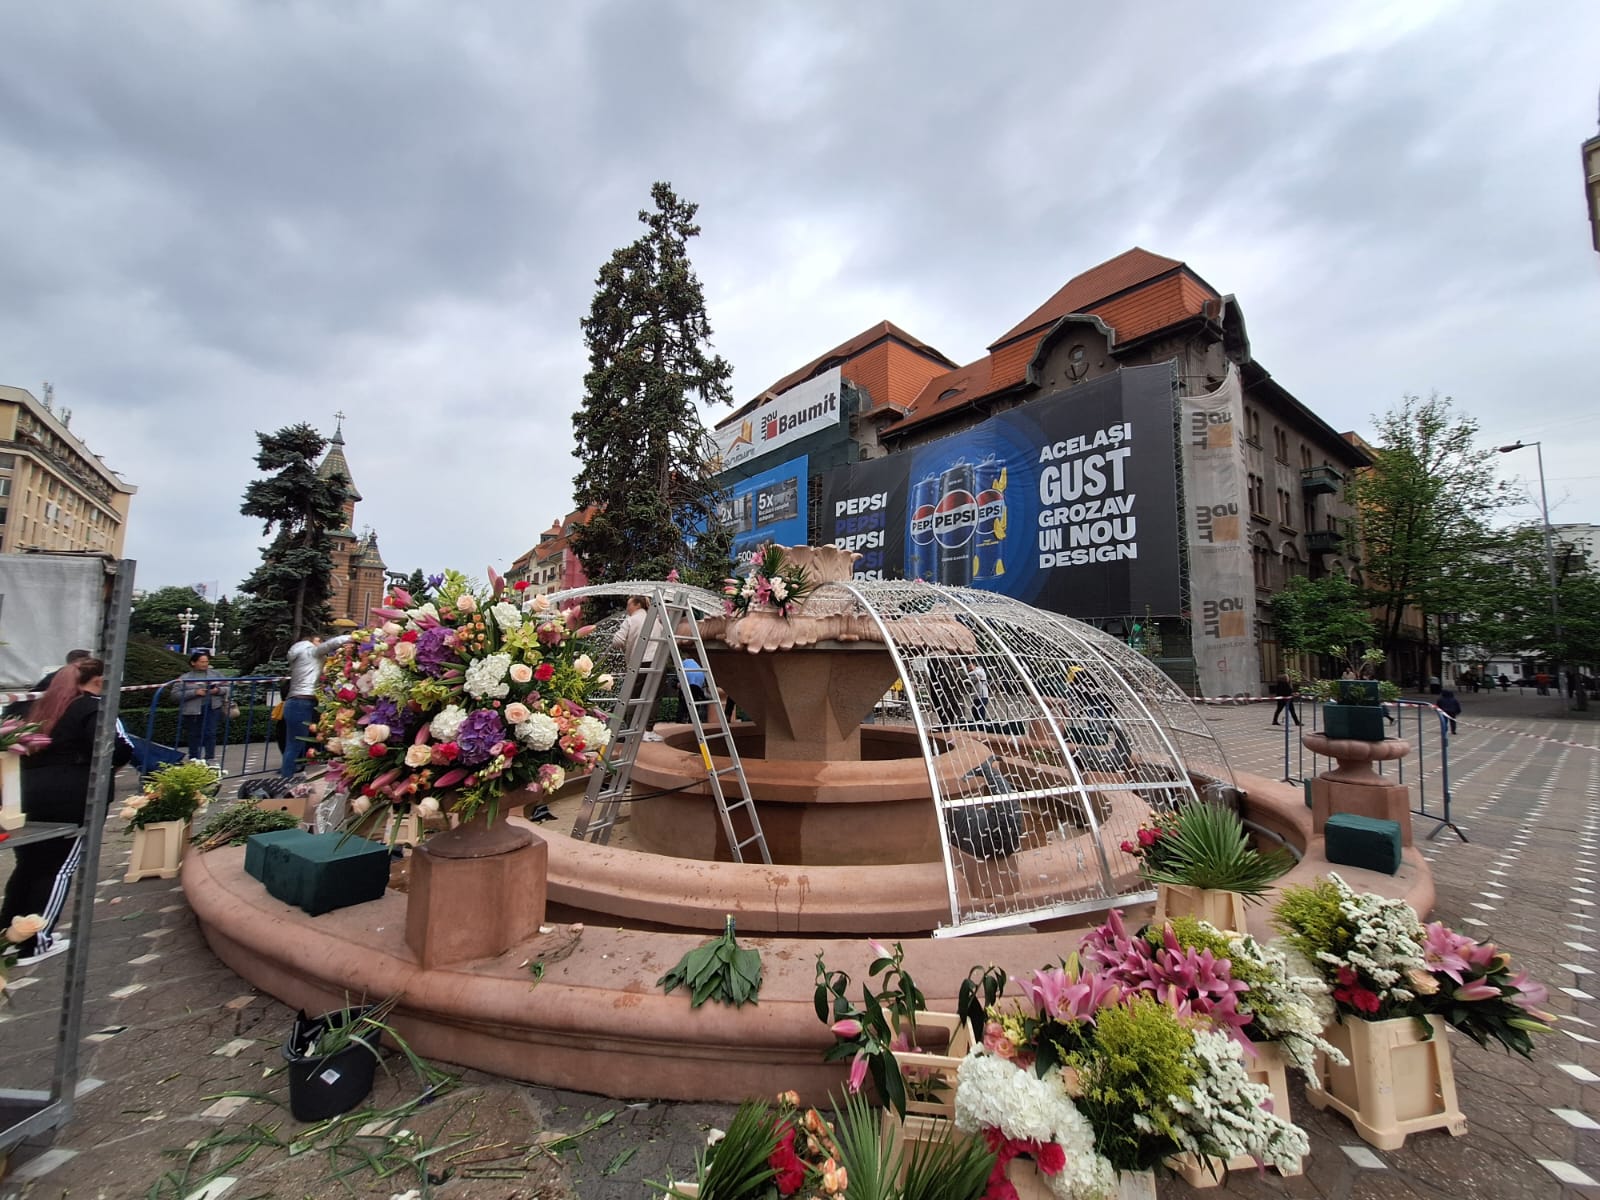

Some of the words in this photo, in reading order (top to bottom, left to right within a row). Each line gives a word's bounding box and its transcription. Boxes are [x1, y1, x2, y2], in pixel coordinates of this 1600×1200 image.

[779, 393, 836, 434] Baumit
[1039, 423, 1131, 463] ACELAȘI
[1039, 447, 1131, 506] GUST
[721, 507, 733, 523] 2x
[759, 493, 774, 510] 5x
[836, 491, 887, 518] PEPSI
[1038, 494, 1136, 527] GROZAV
[835, 511, 886, 536] PEPSI
[935, 509, 977, 528] PEPSI
[835, 530, 885, 551] PEPSI
[1039, 528, 1062, 551] UN
[1070, 516, 1136, 547] NOU
[1039, 542, 1138, 569] DESIGN
